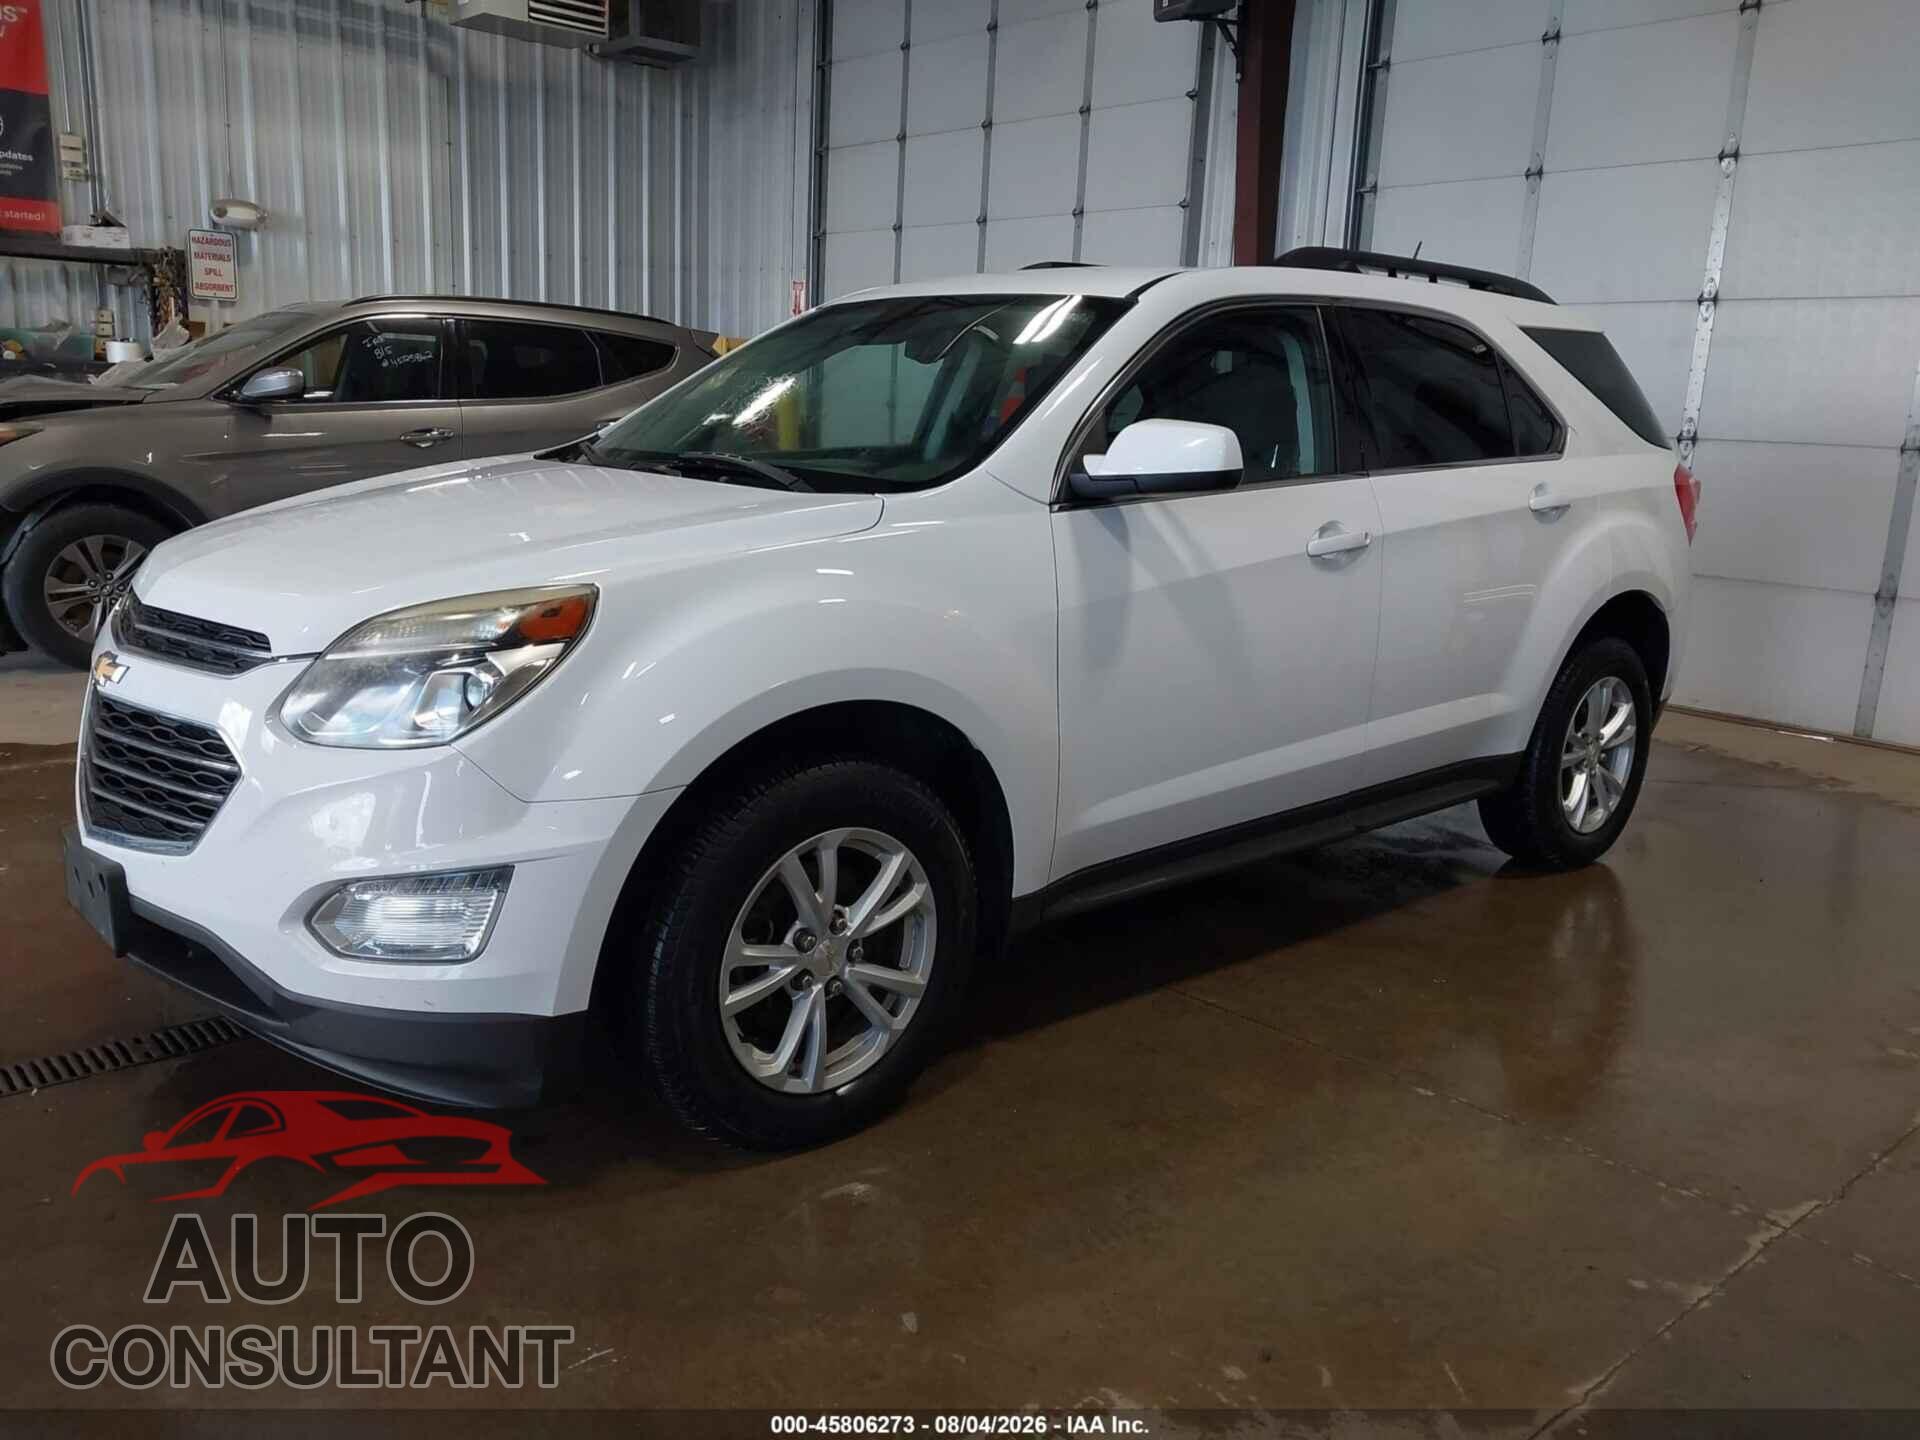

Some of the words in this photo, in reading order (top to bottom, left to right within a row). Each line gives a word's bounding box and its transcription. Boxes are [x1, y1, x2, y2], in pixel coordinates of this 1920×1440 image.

[192, 236, 232, 247] HAZARDOUS
[194, 252, 232, 262] MATERIALS
[204, 267, 223, 277] SPILL
[195, 282, 233, 292] ABSORBENT
